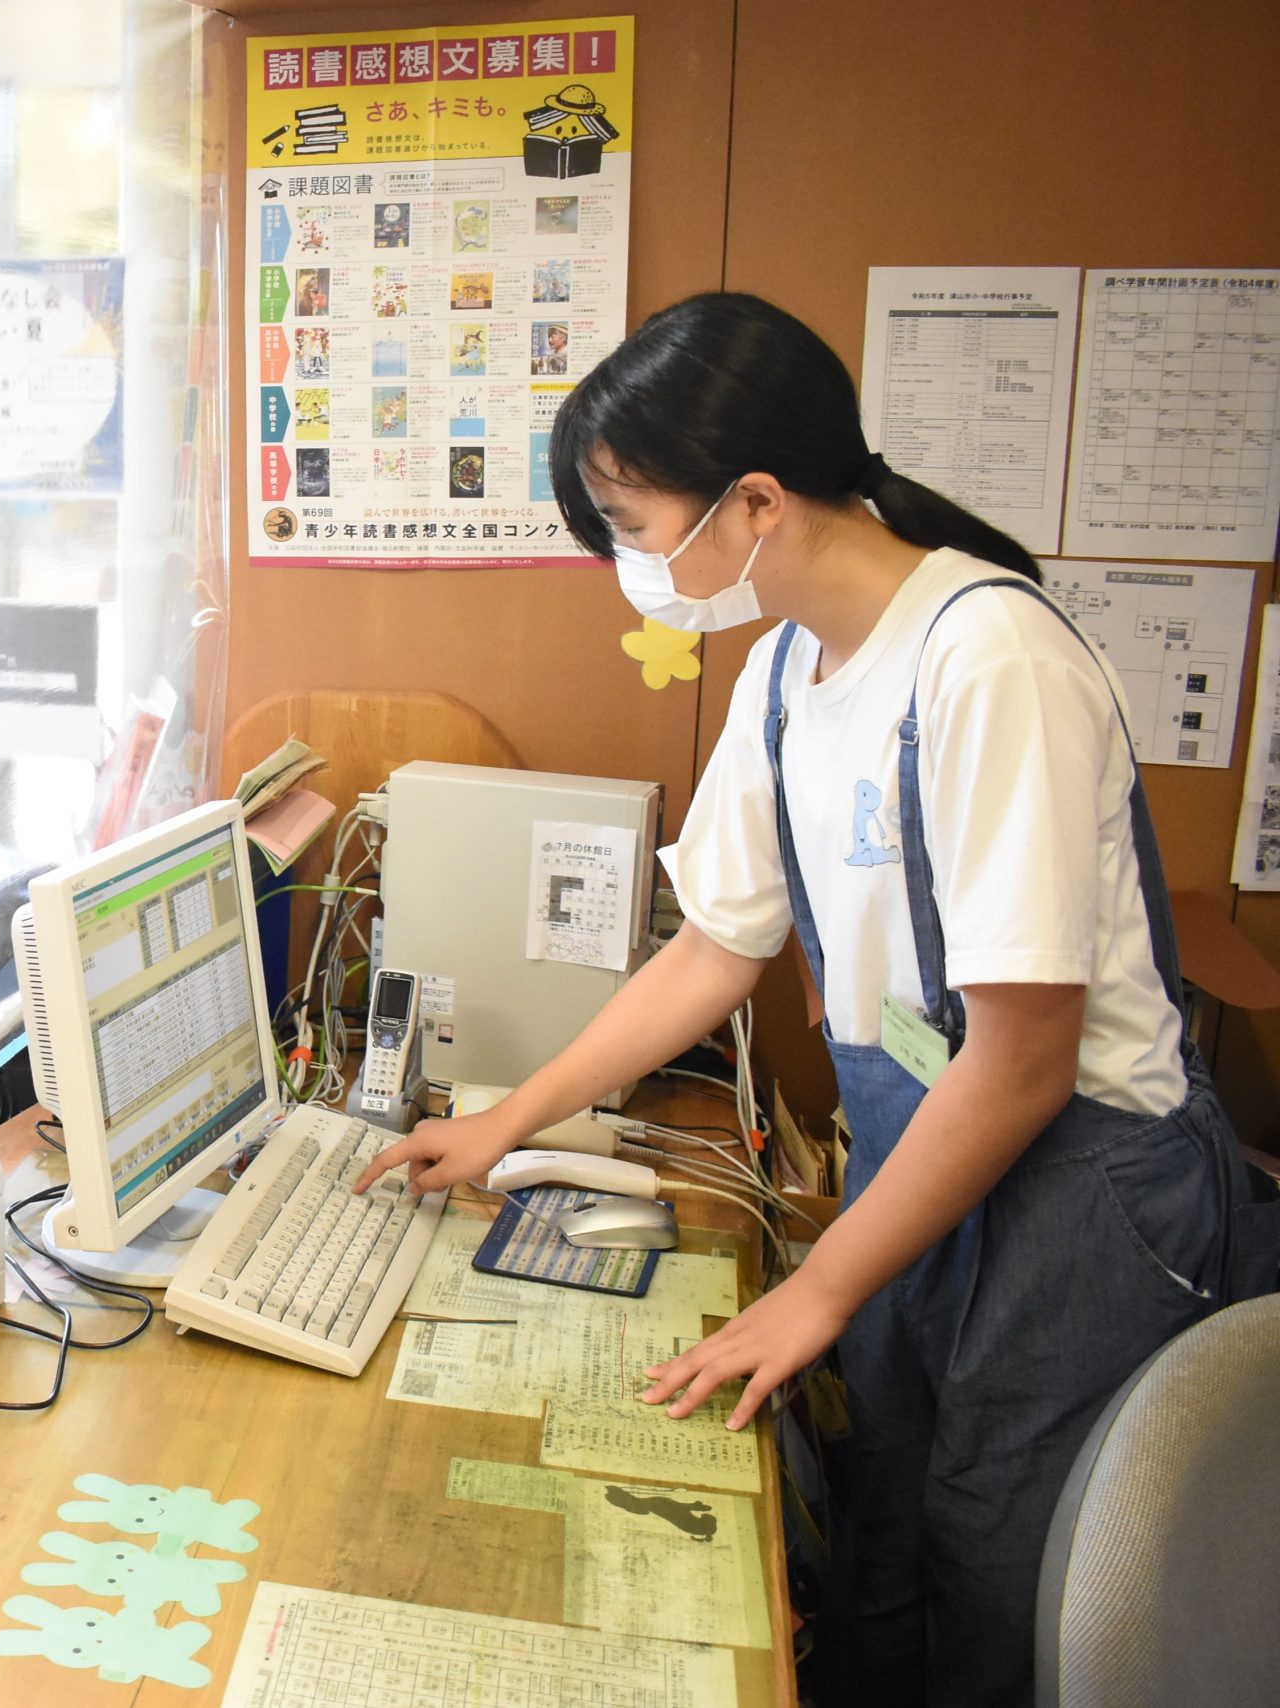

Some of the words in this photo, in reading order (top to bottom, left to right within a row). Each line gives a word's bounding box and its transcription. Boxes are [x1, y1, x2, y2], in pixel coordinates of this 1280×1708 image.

[267, 34, 601, 87] 読書感想文募集！
[366, 96, 507, 122] さあ、キミも。
[288, 173, 374, 198] 課題図書
[302, 508, 333, 518] 第69回
[305, 523, 571, 539] 青少年読書感想文全国コンク
